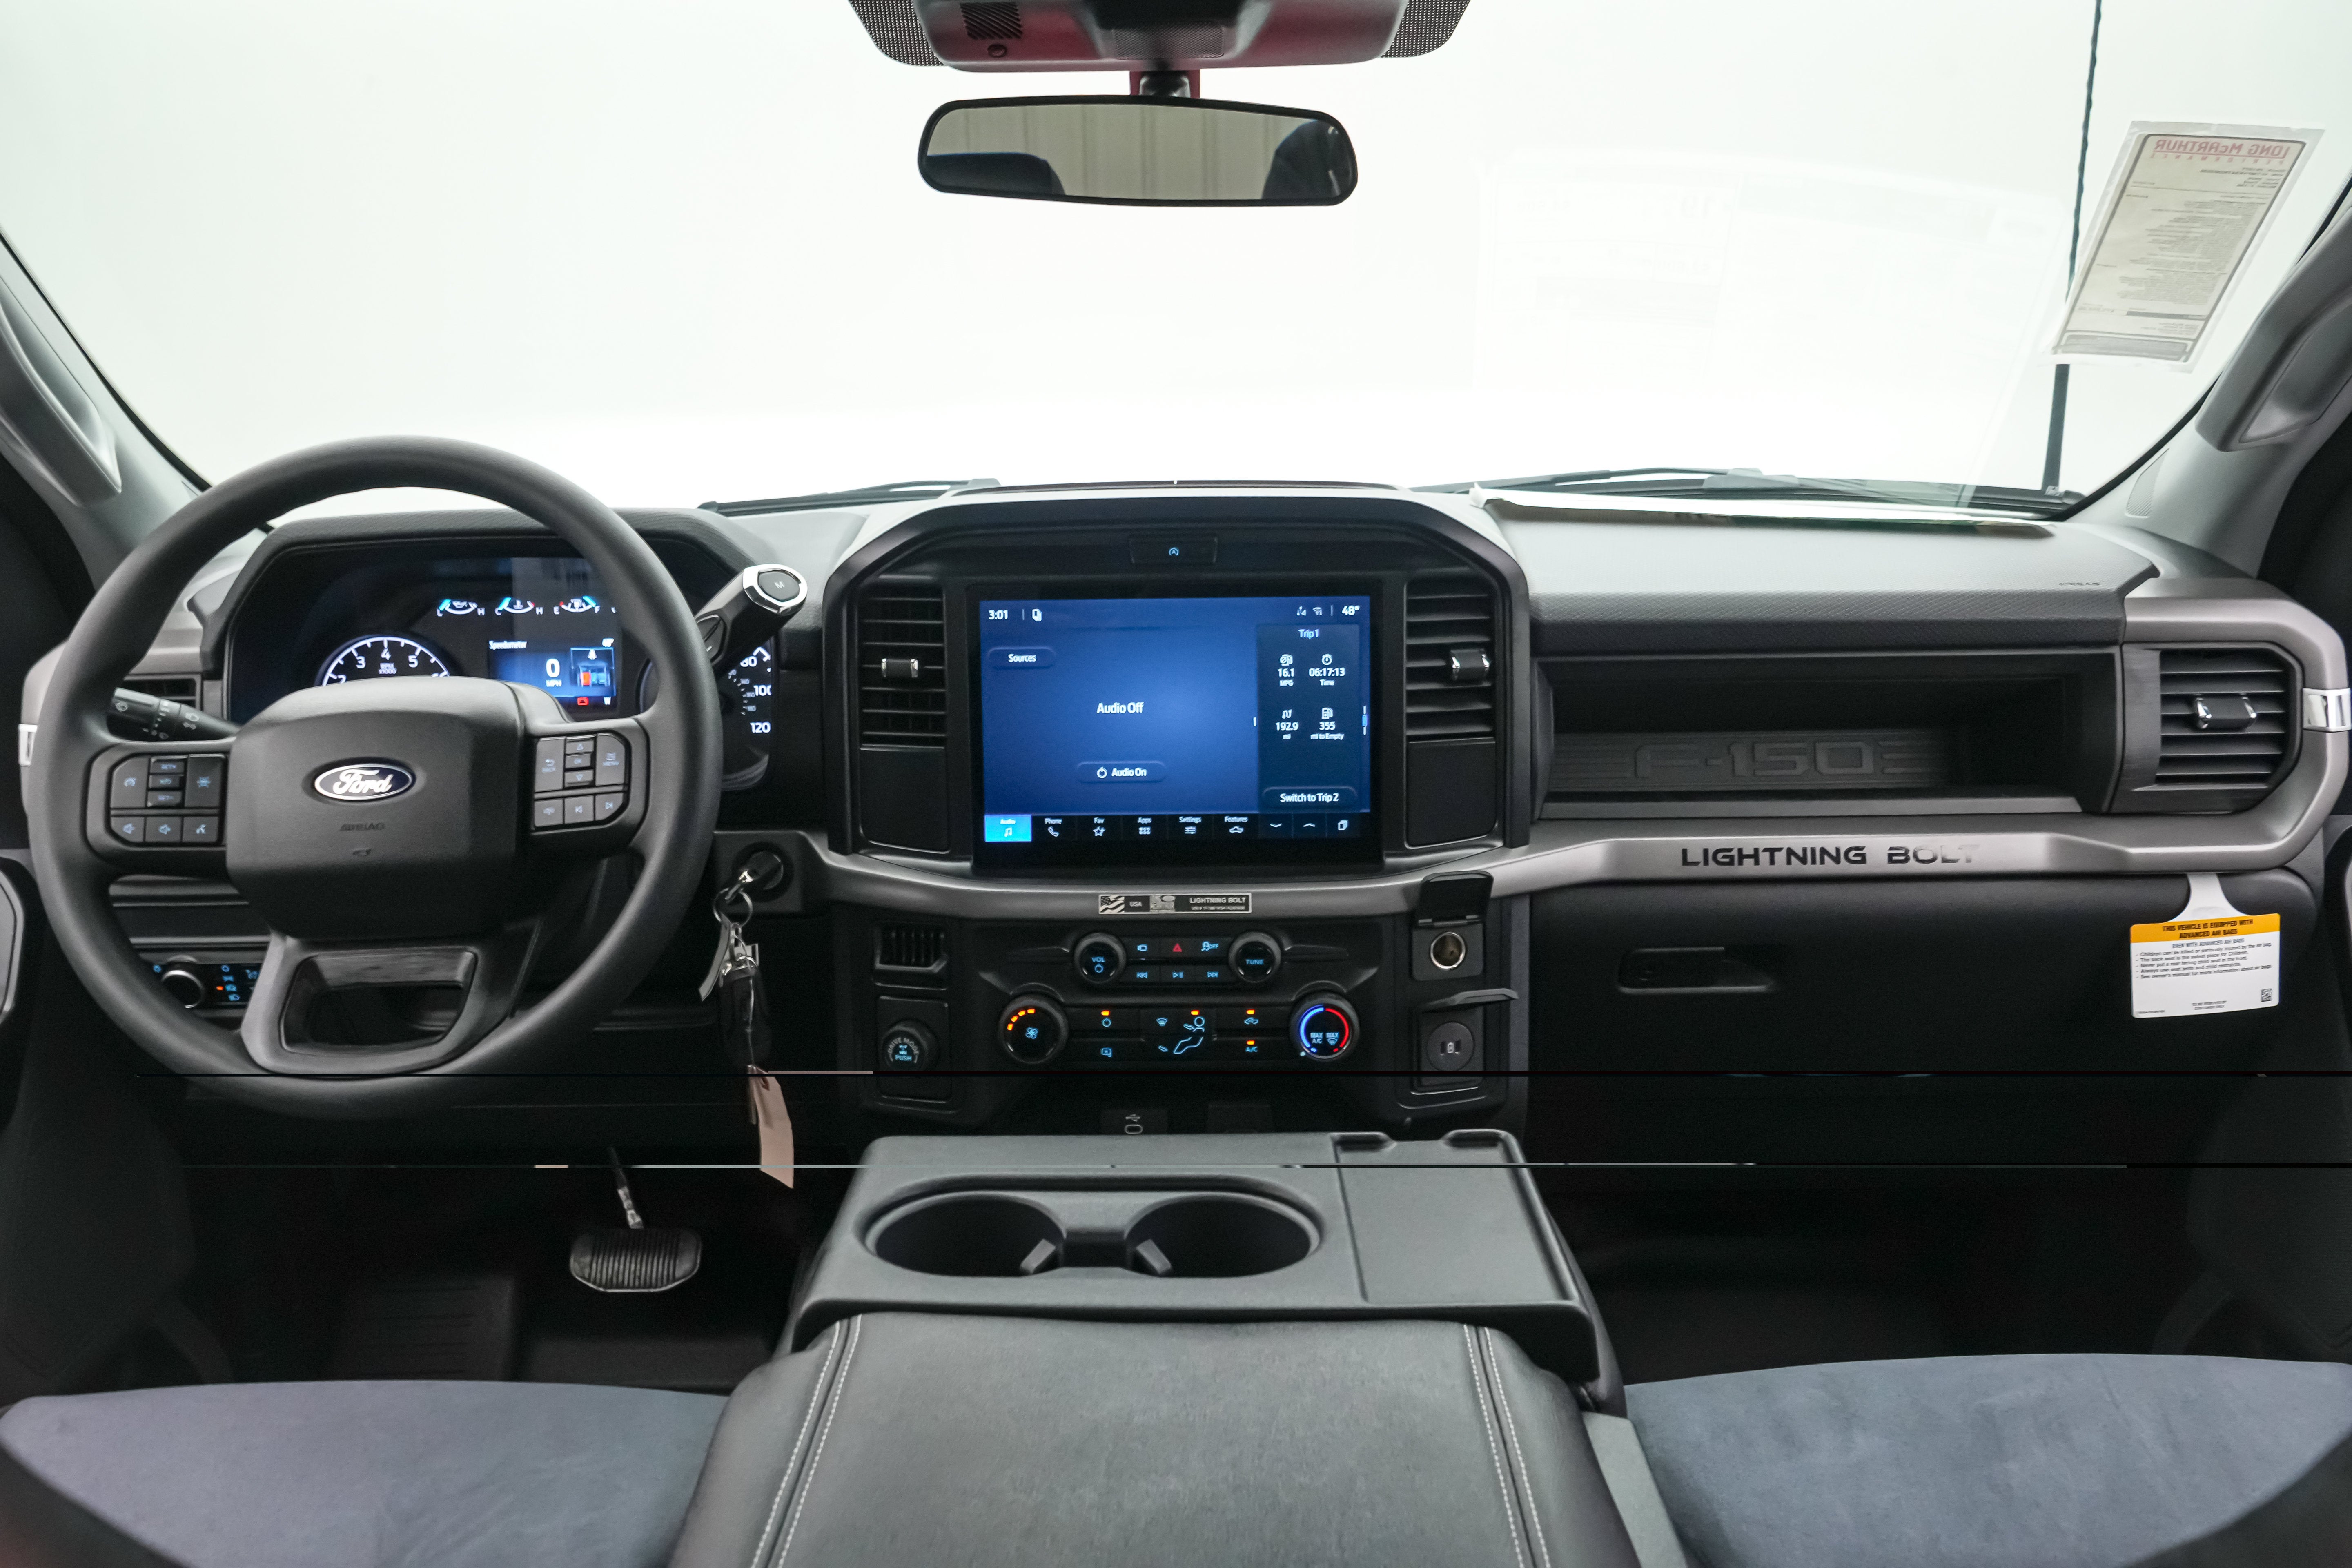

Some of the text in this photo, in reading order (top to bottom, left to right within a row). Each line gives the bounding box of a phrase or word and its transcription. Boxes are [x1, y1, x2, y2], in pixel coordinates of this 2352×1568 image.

[477, 608, 485, 616] H
[536, 607, 543, 615] H
[553, 606, 560, 615] E
[594, 606, 600, 614] F
[989, 610, 1008, 620] 3:01
[1341, 605, 1360, 616] 48°
[1298, 628, 1315, 639] Trip
[489, 640, 527, 650] Speedometer
[381, 648, 391, 660] 4
[1008, 653, 1037, 662] Sources
[356, 656, 366, 669] 3
[408, 655, 418, 668] 5
[546, 658, 560, 678] 0
[1277, 668, 1295, 677] 16.1
[1308, 667, 1345, 677] 06:17:13
[1096, 702, 1145, 714] Audio Off
[750, 722, 771, 733] 120
[1275, 722, 1299, 731] 192.9
[1319, 721, 1336, 730] 355
[1635, 742, 1873, 777] F-150
[1111, 767, 1147, 777] Audio On
[332, 769, 394, 795] Ford
[1280, 793, 1339, 803] Switch to Trip 2
[1682, 844, 1980, 866] LIGHTNING BOLT
